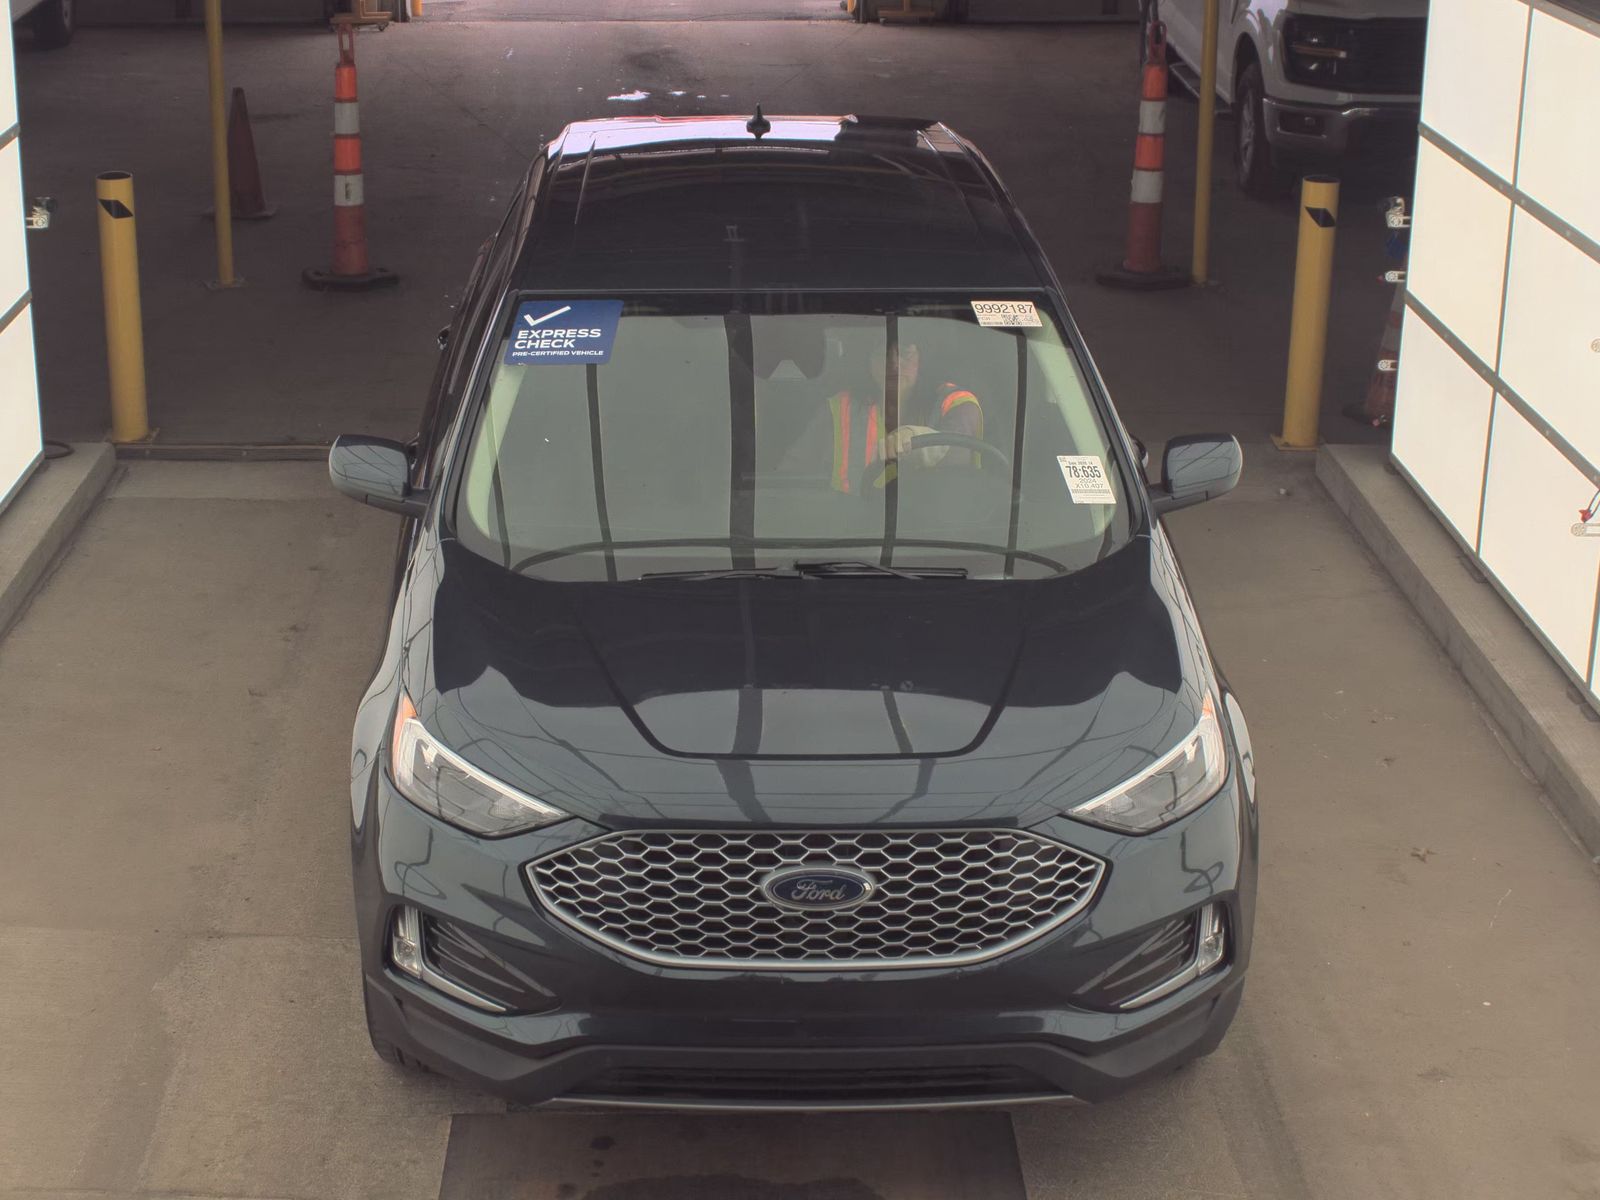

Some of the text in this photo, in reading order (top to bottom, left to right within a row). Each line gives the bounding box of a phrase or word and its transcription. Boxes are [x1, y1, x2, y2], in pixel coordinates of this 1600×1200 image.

[974, 303, 1033, 314] 9992187
[517, 328, 602, 340] EXPRESS
[514, 339, 576, 349] CHECK
[1065, 465, 1102, 478] 78:635
[791, 879, 845, 900] Ford
